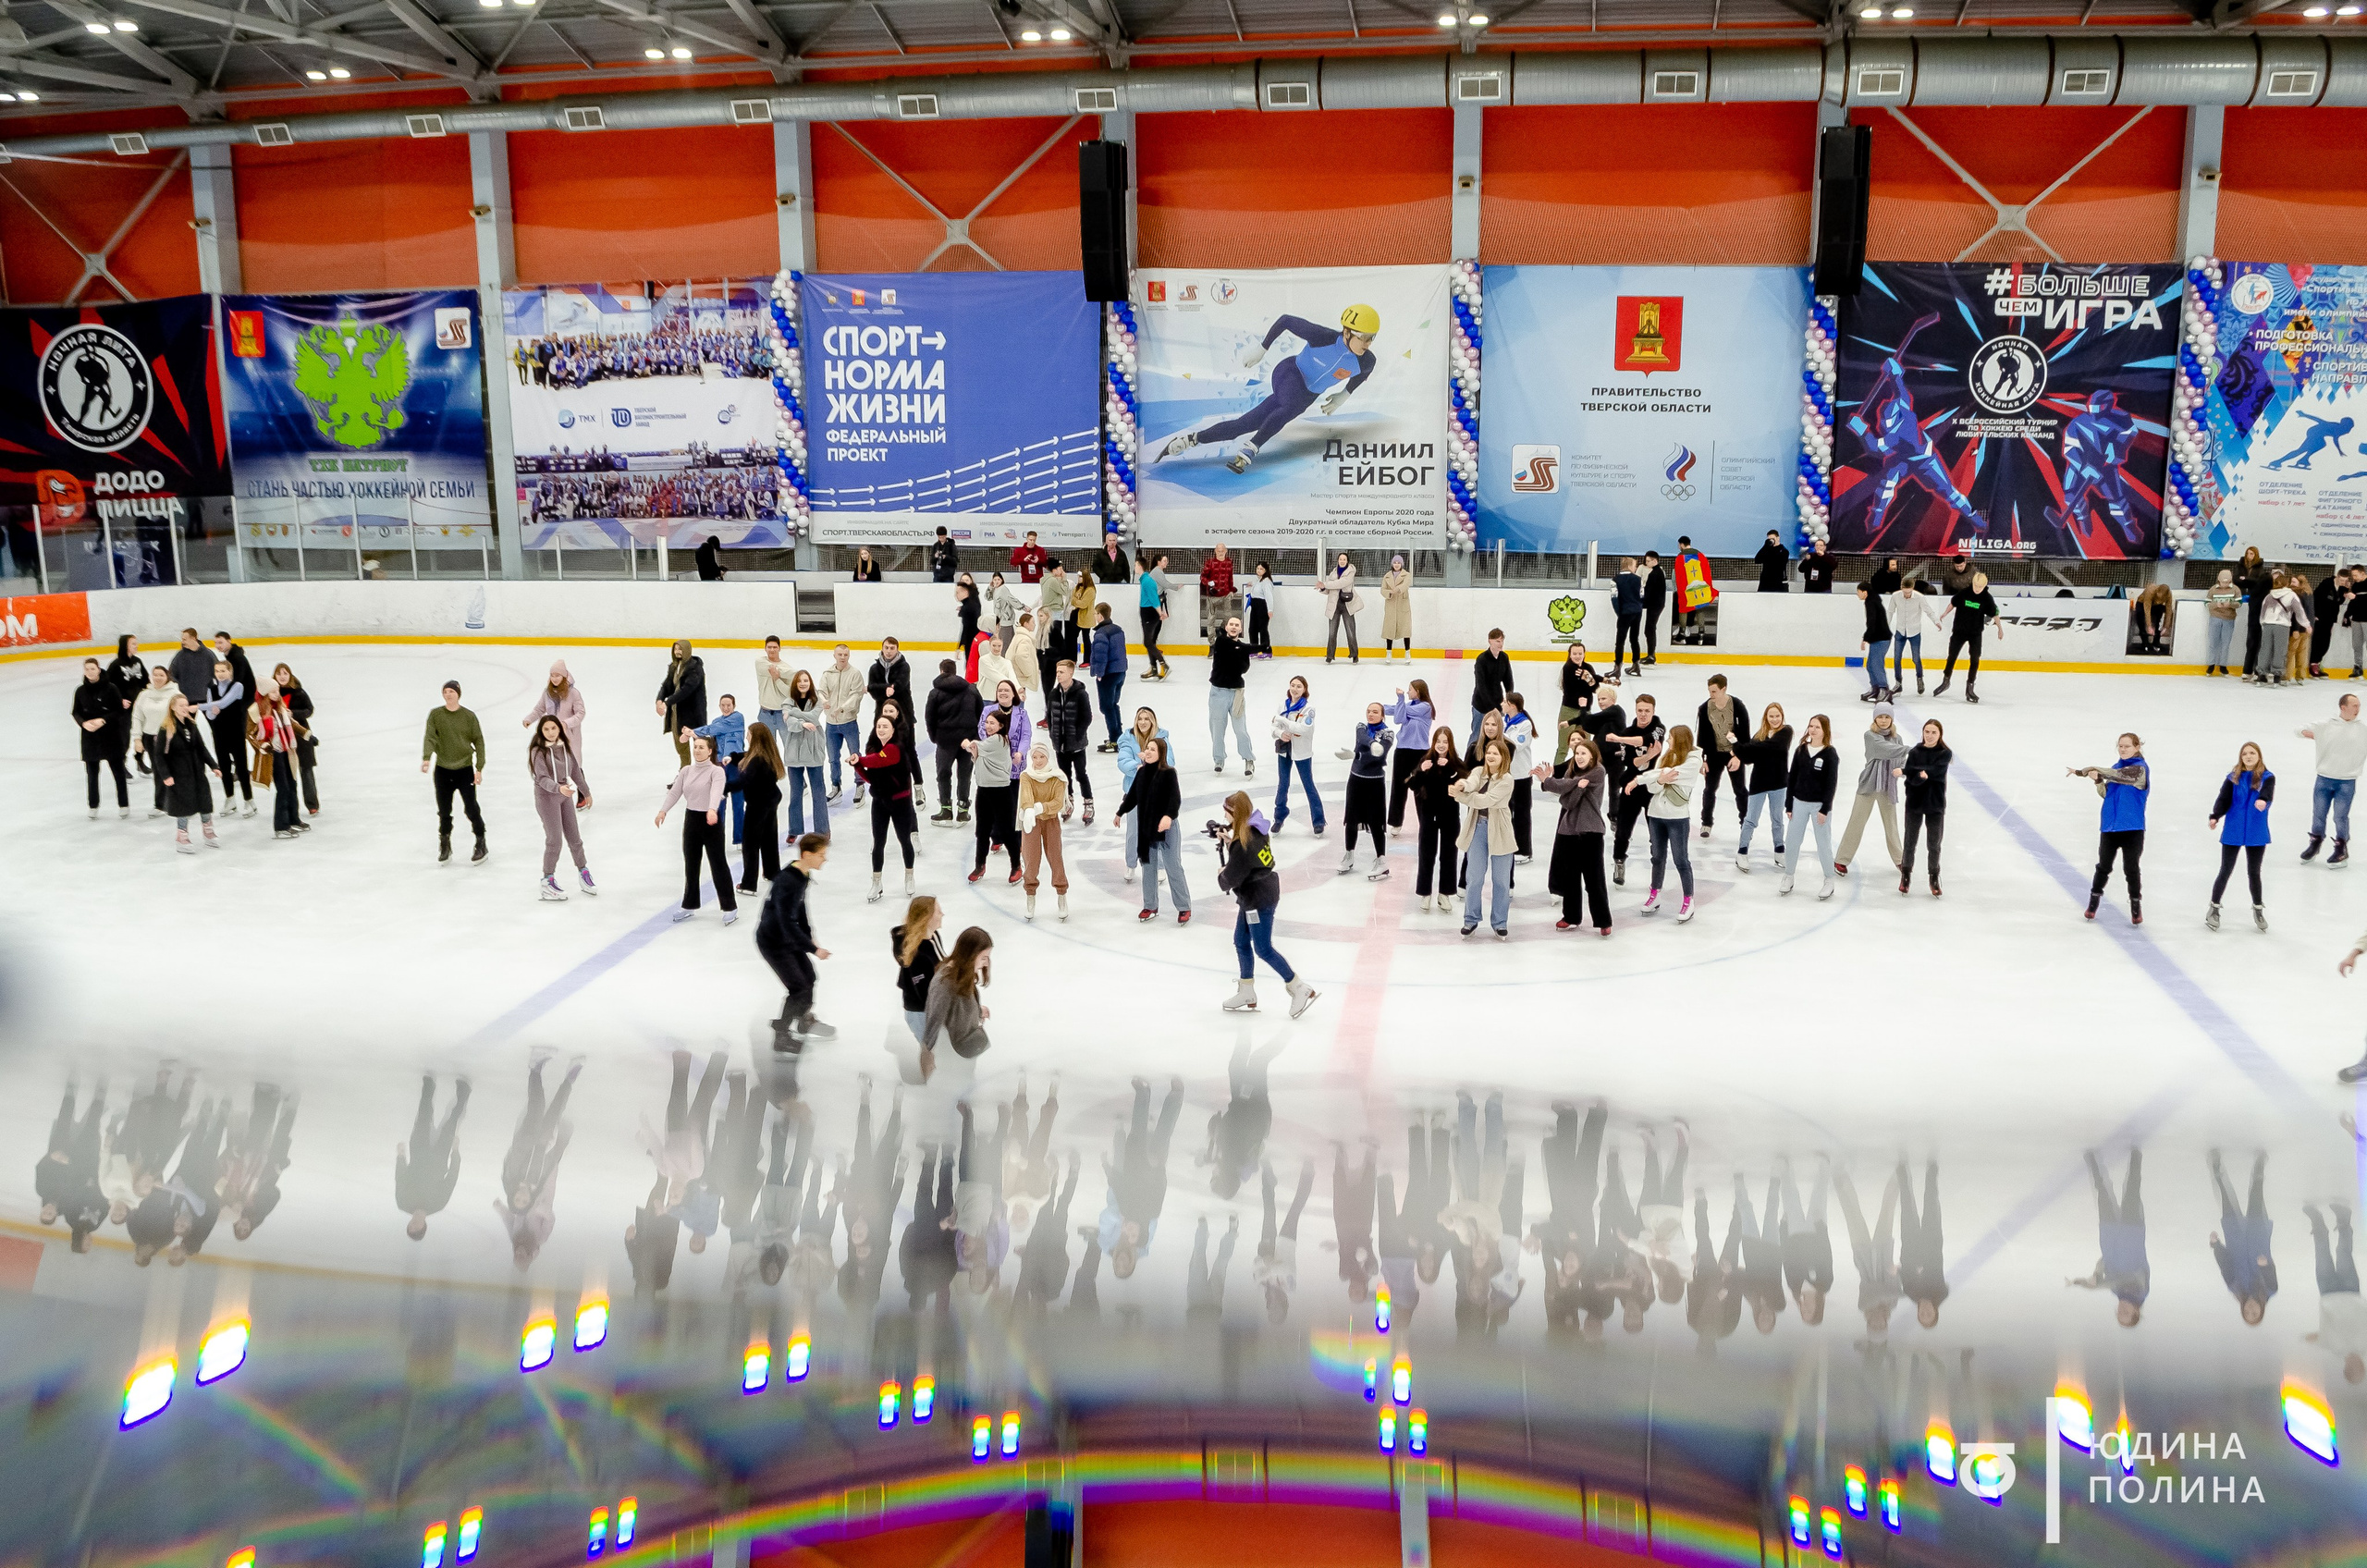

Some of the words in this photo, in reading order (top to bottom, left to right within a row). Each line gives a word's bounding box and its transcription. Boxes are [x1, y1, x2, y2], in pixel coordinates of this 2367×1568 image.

[1984, 268, 2151, 297] #БОЛЬШЕ
[1999, 301, 2038, 312] ЧЕМ
[2044, 299, 2163, 330] ИГРА
[823, 325, 923, 356] СПОРТ
[1991, 340, 2030, 351] НОЧНАЯ
[2256, 329, 2334, 341] ПОДГОТОВКА
[47, 332, 98, 372] НОЧНАЯ
[825, 359, 945, 390] НОРМА
[1591, 387, 1701, 398] ПРАВИТЕЛЬСТВО
[1975, 382, 2020, 409] ХОККЕЙНАЯ
[2023, 382, 2041, 403] ЛИГА
[825, 394, 946, 424] ЖИЗНИ
[1580, 402, 1647, 412] ТВЕРСКОЙ
[1650, 403, 1711, 413] ОБЛАСТИ
[826, 426, 947, 446] ФЕДЕРАЛЬНЫЙ
[827, 447, 889, 462] ПРОЕКТ
[1322, 439, 1434, 462] Даниил
[93, 470, 166, 496] ДОДО
[1339, 461, 1435, 485] ЕЙБОГ
[248, 480, 289, 498] СТАНЬ
[291, 480, 345, 498] ЧАСТЬЮ
[348, 477, 426, 498] ХОККЕЙНОЙ
[430, 480, 475, 498] СЕМЬИ
[95, 496, 184, 521] ПИЦЦА
[1364, 509, 1394, 518] Европы
[1958, 538, 2037, 550] NHLIGA.ORG
